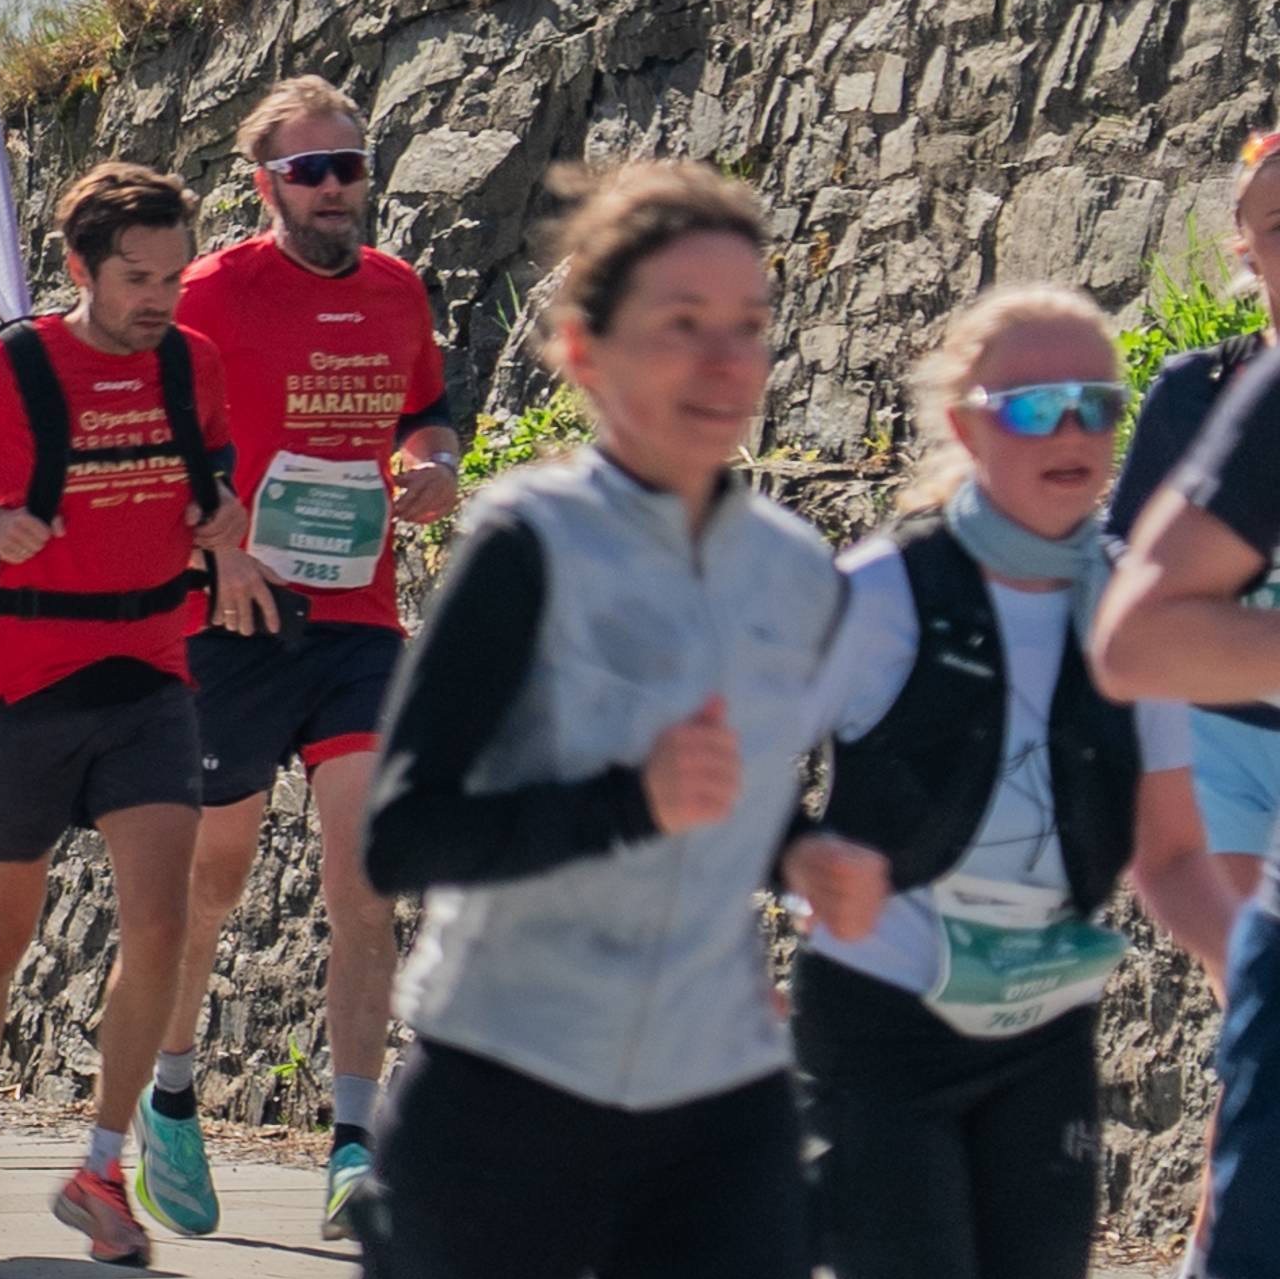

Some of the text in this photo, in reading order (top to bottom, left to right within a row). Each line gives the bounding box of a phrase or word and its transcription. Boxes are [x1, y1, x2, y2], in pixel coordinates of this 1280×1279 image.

[287, 374, 366, 391] BERGEN
[287, 392, 406, 413] MARATHON
[71, 432, 144, 451] ERGEN
[293, 560, 341, 581] 7885
